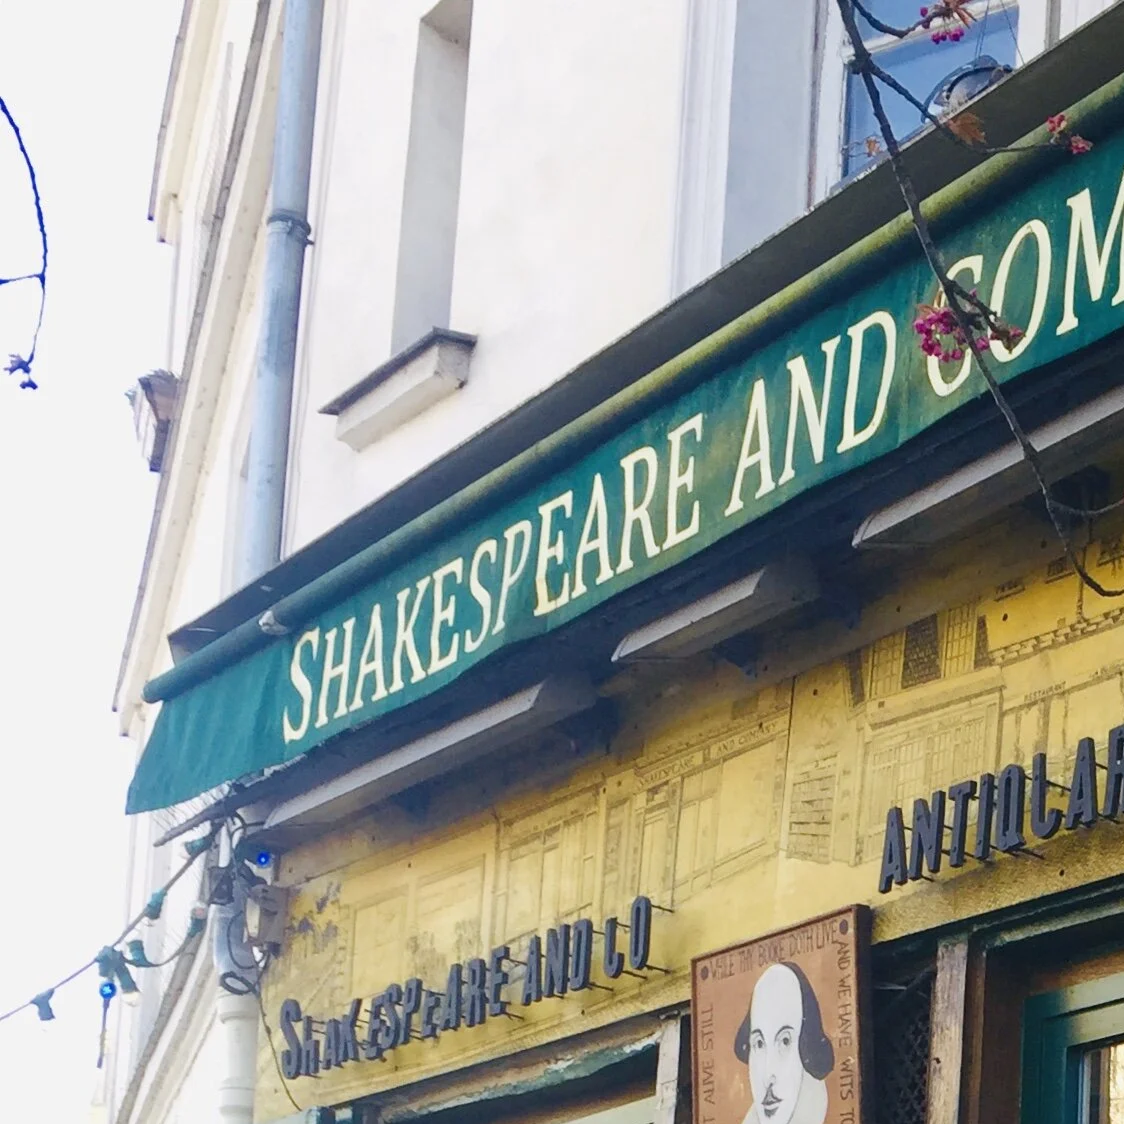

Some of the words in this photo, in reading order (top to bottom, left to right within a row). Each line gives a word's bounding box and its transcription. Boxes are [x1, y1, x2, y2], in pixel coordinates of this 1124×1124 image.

[282, 413, 703, 744] SHAKESPEARE
[724, 310, 897, 518] AND
[816, 920, 838, 949] LIVE
[836, 940, 852, 970] AND
[522, 919, 594, 1006] AND
[838, 975, 852, 998] WE
[701, 1003, 714, 1050] STILL
[838, 1005, 852, 1048] HAVE
[702, 1061, 715, 1105] ALIVE
[839, 1060, 853, 1100] WITS
